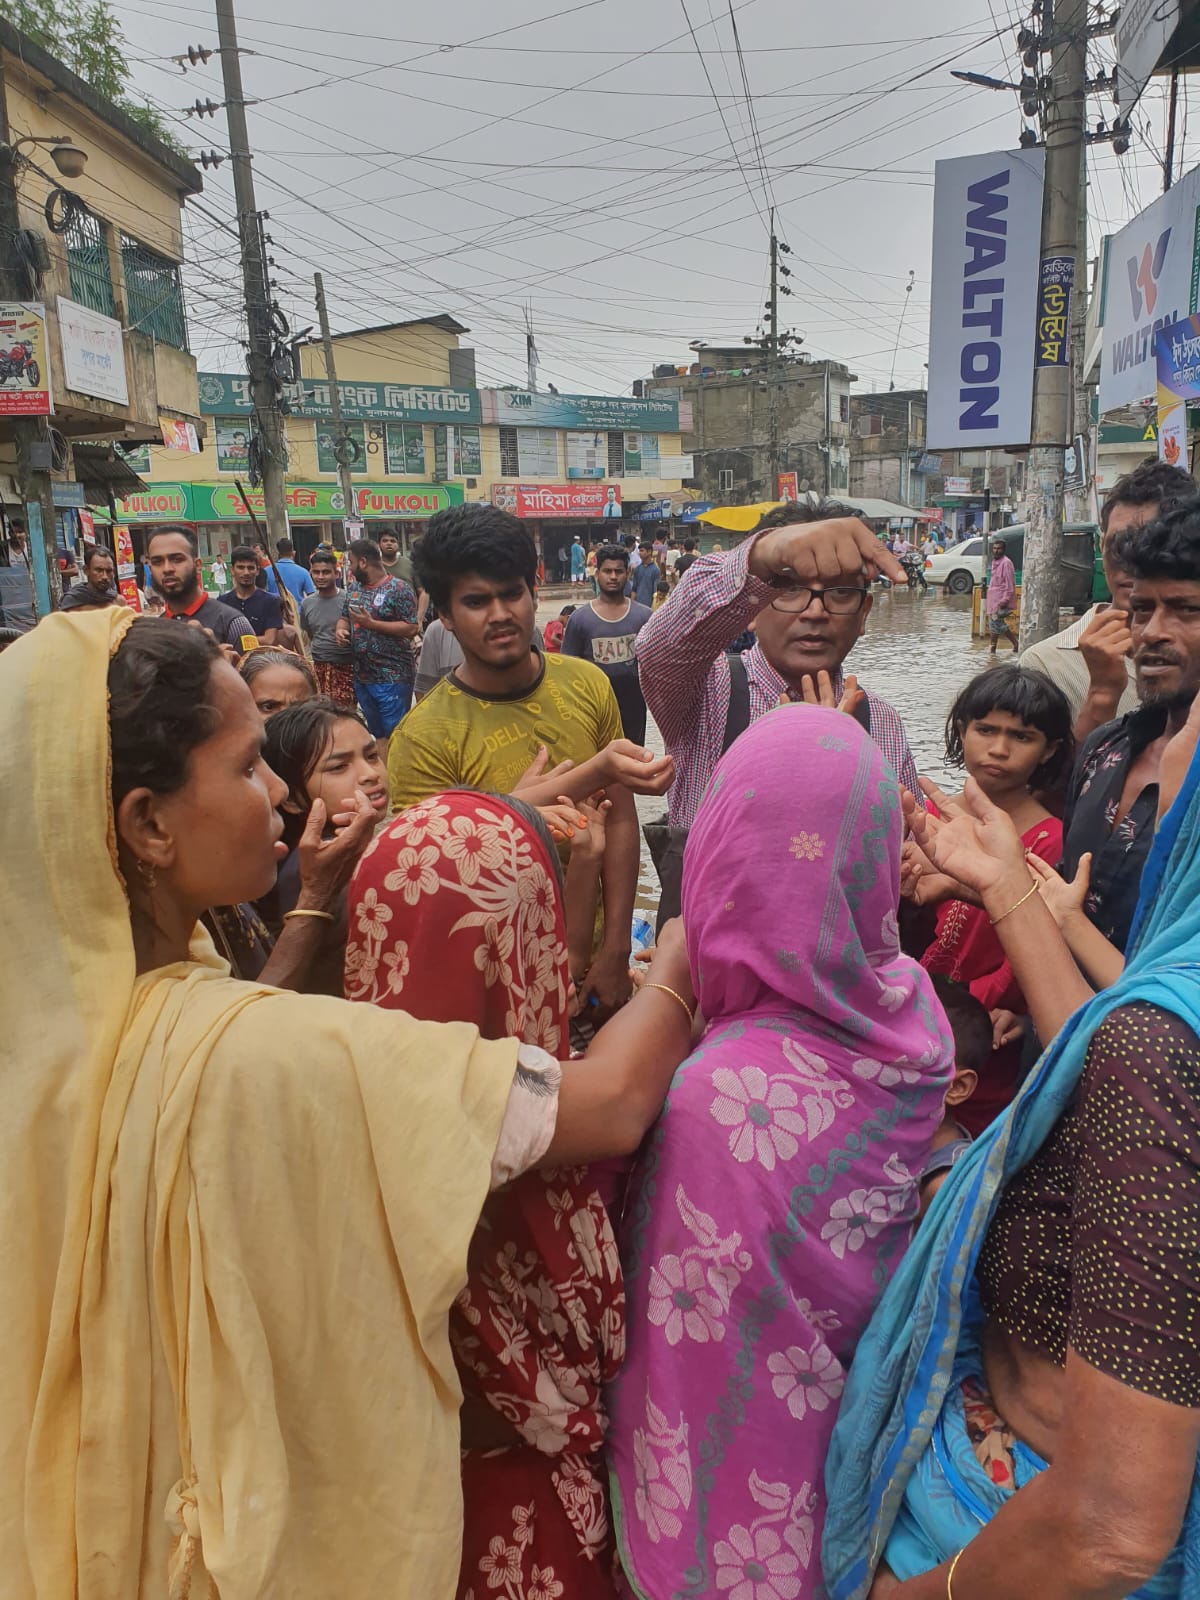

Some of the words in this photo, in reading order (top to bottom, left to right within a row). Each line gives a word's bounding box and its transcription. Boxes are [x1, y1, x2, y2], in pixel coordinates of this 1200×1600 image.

[959, 169, 1010, 431] WALTON
[383, 385, 471, 412] লিমিটেড
[522, 489, 571, 511] মাহিমা
[546, 679, 573, 721] WORLD
[483, 722, 528, 753] DELL
